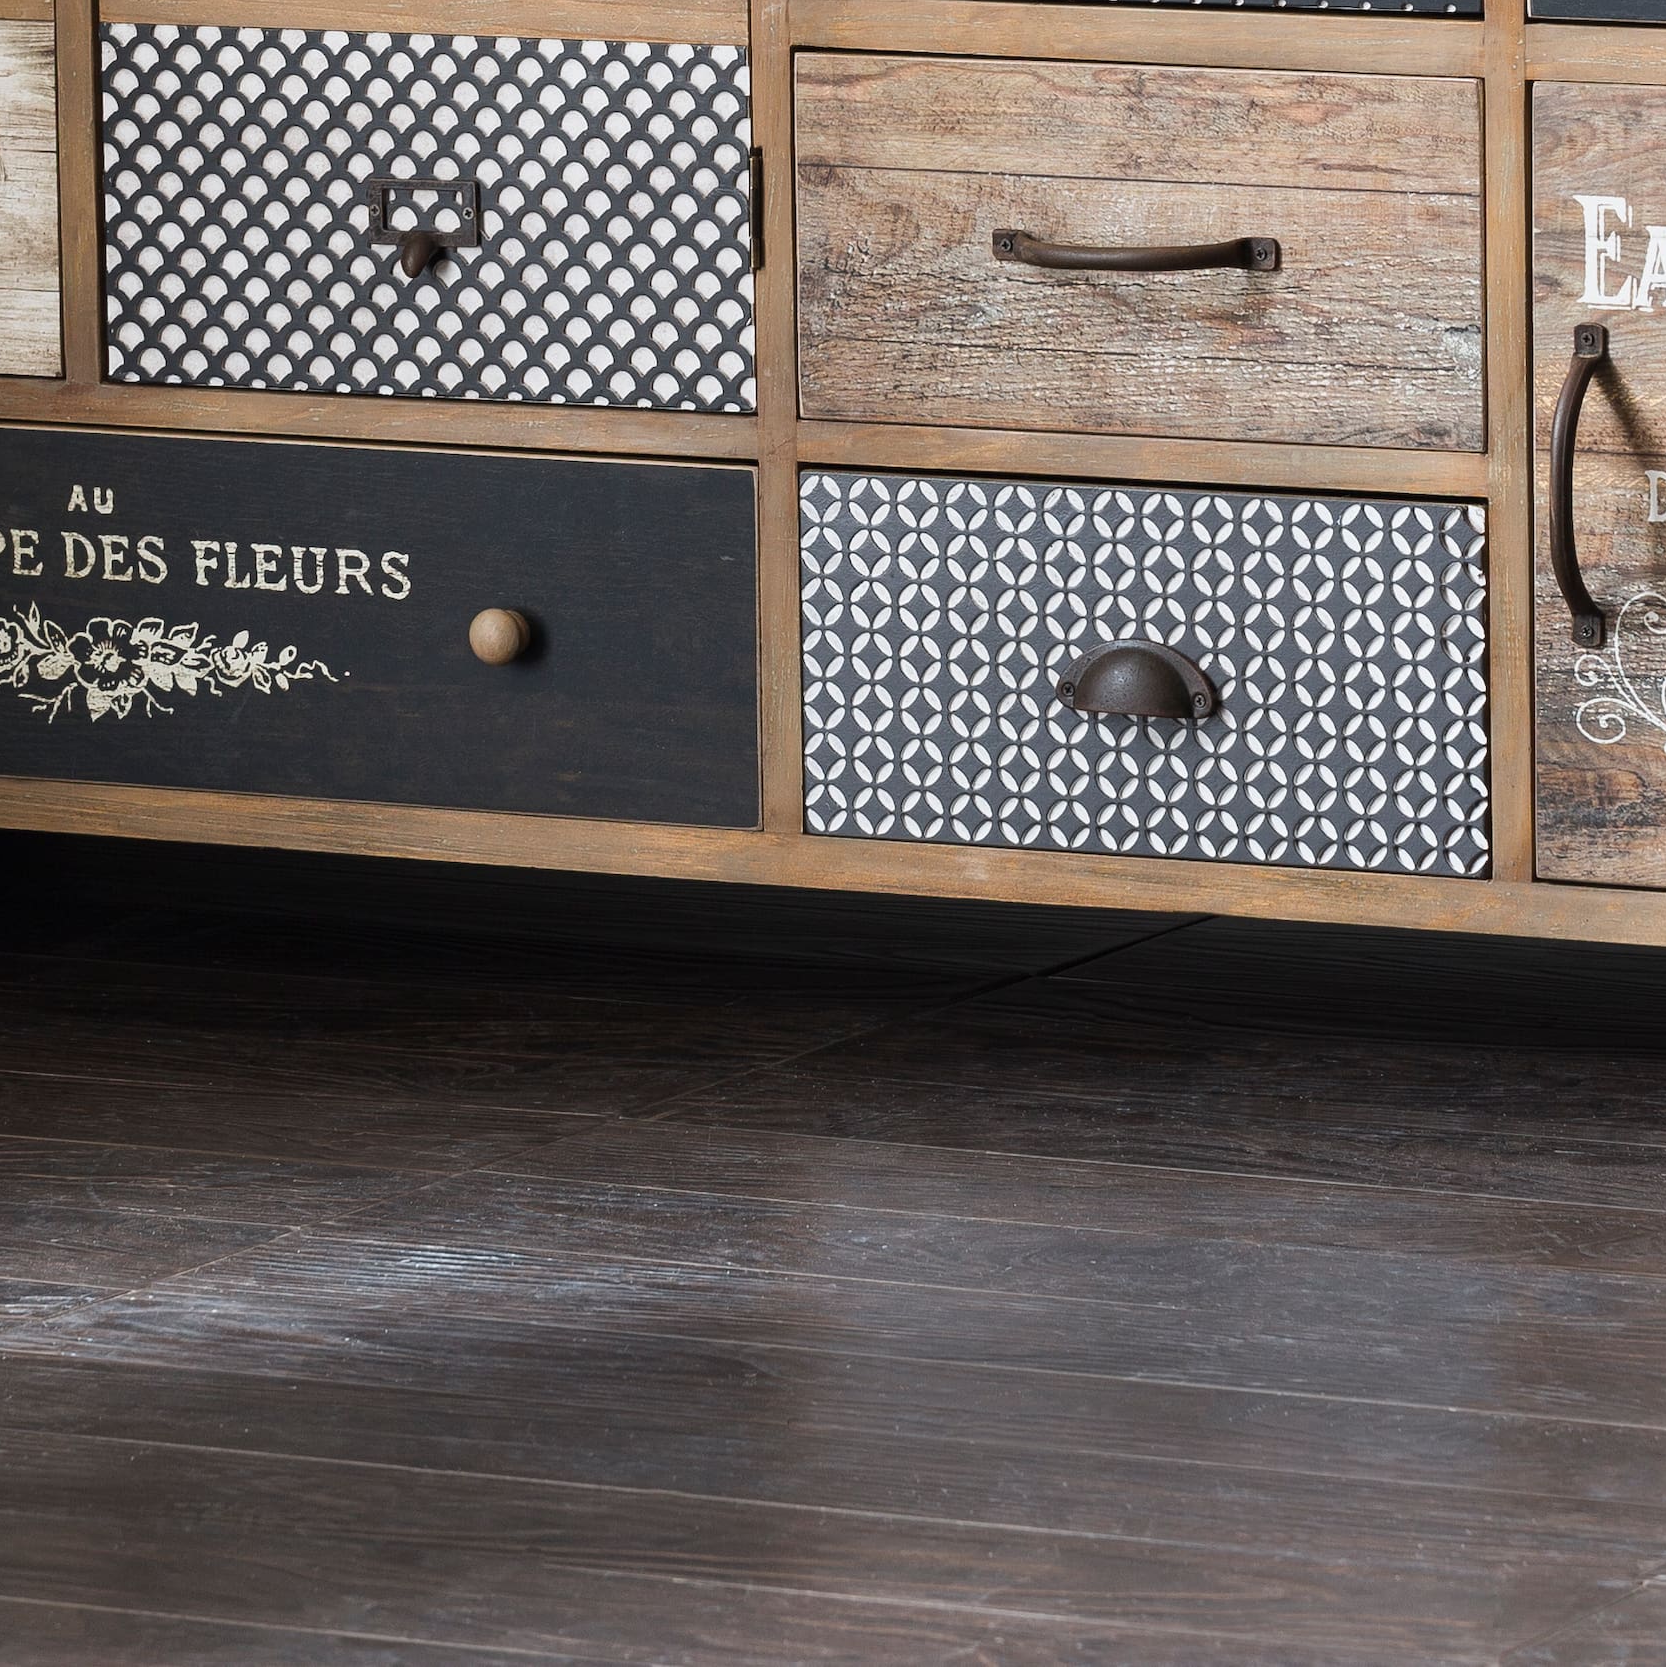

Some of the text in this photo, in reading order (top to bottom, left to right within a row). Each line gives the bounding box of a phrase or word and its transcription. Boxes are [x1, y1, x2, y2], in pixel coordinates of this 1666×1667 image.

[67, 484, 115, 515] AU
[62, 533, 170, 587] DES
[190, 539, 414, 601] FLEURS
